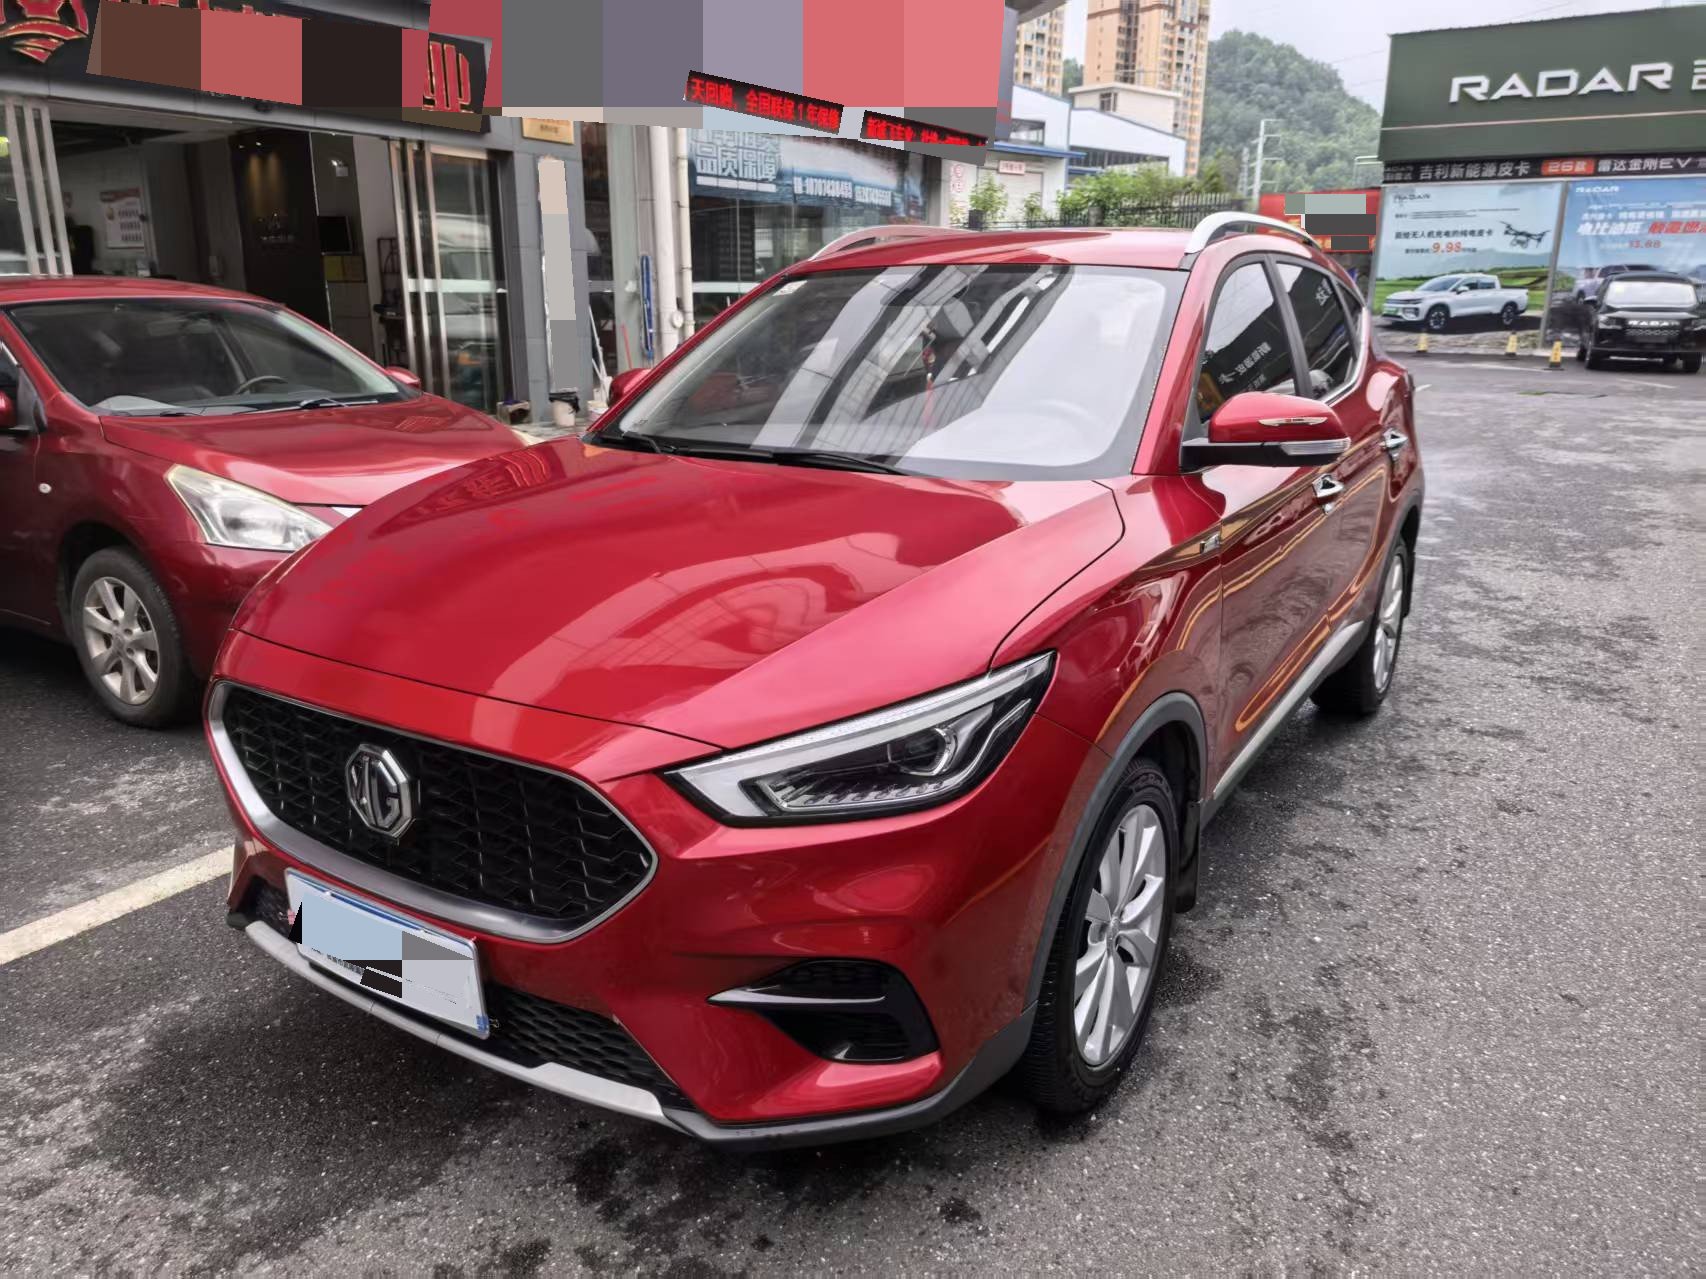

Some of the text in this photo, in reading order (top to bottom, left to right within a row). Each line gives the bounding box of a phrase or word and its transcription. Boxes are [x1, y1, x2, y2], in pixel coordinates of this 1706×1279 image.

[1449, 61, 1674, 104] RADAR
[695, 141, 778, 182] 品质保障
[1418, 160, 1531, 180] 吉利新能源皮卡
[1575, 185, 1620, 193] RADAR
[1432, 241, 1462, 254] 9.98
